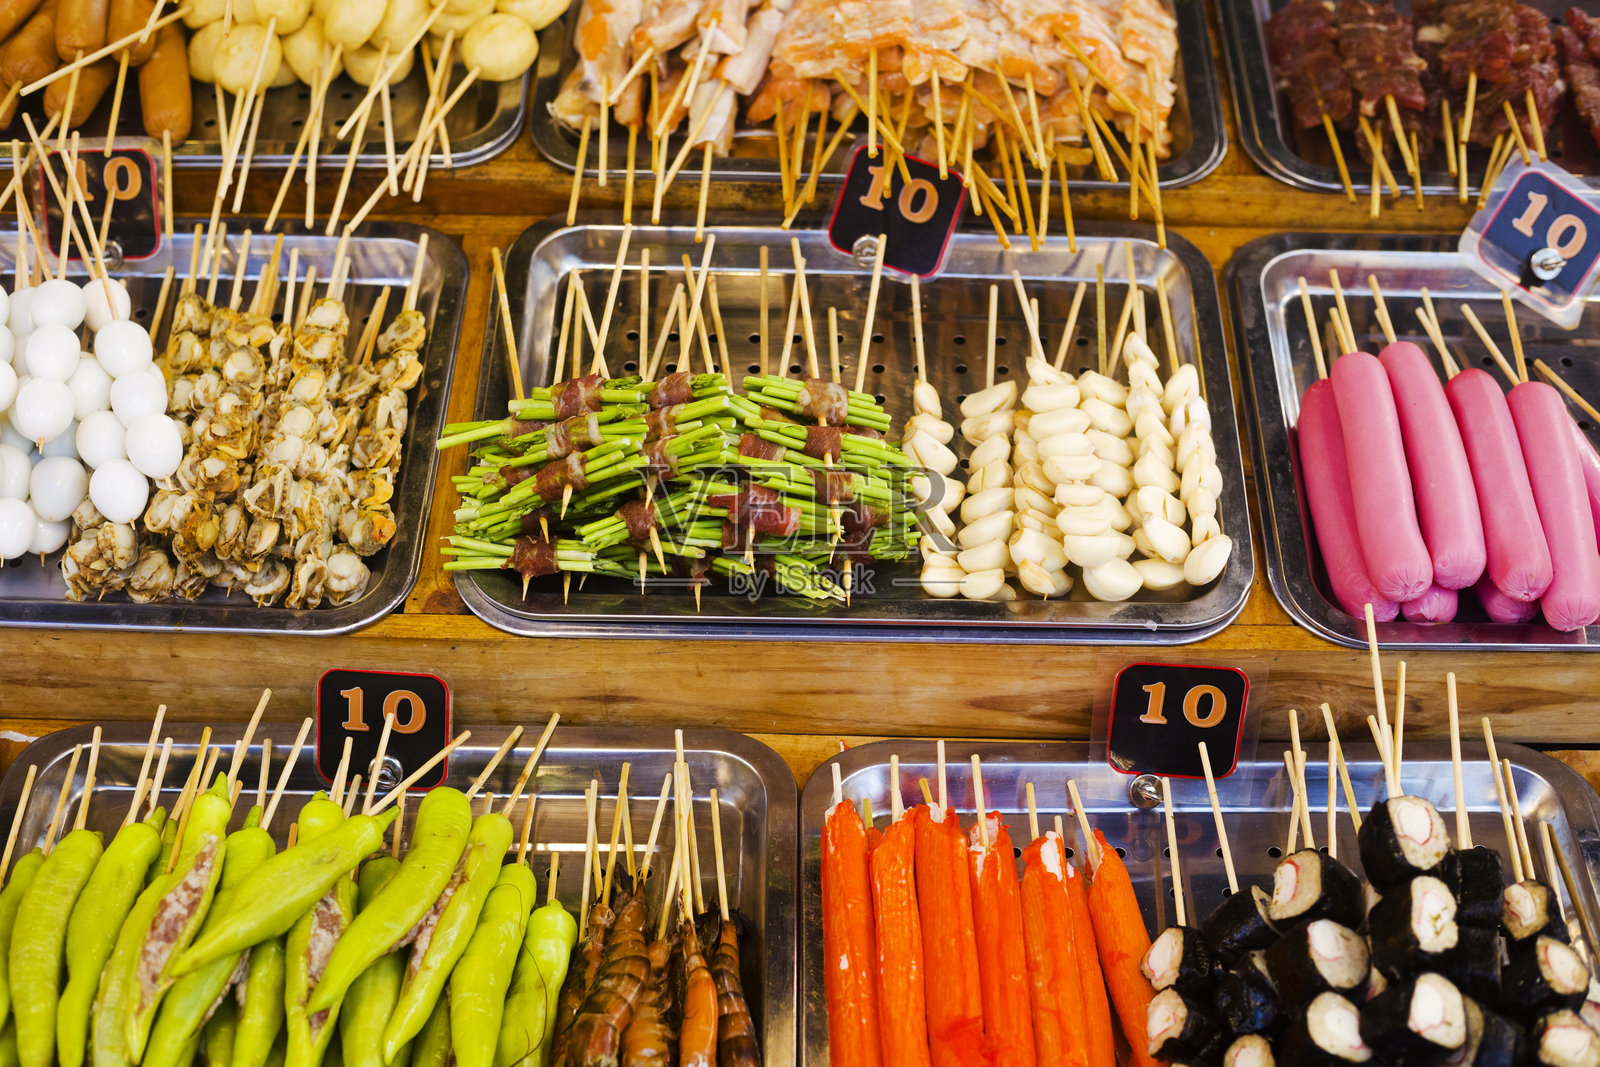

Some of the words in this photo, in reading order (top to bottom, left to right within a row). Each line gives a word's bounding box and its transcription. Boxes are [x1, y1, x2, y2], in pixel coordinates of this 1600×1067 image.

[859, 165, 939, 224] 10
[1512, 191, 1587, 259] 10
[340, 686, 427, 734] 10
[1139, 681, 1228, 728] 10
